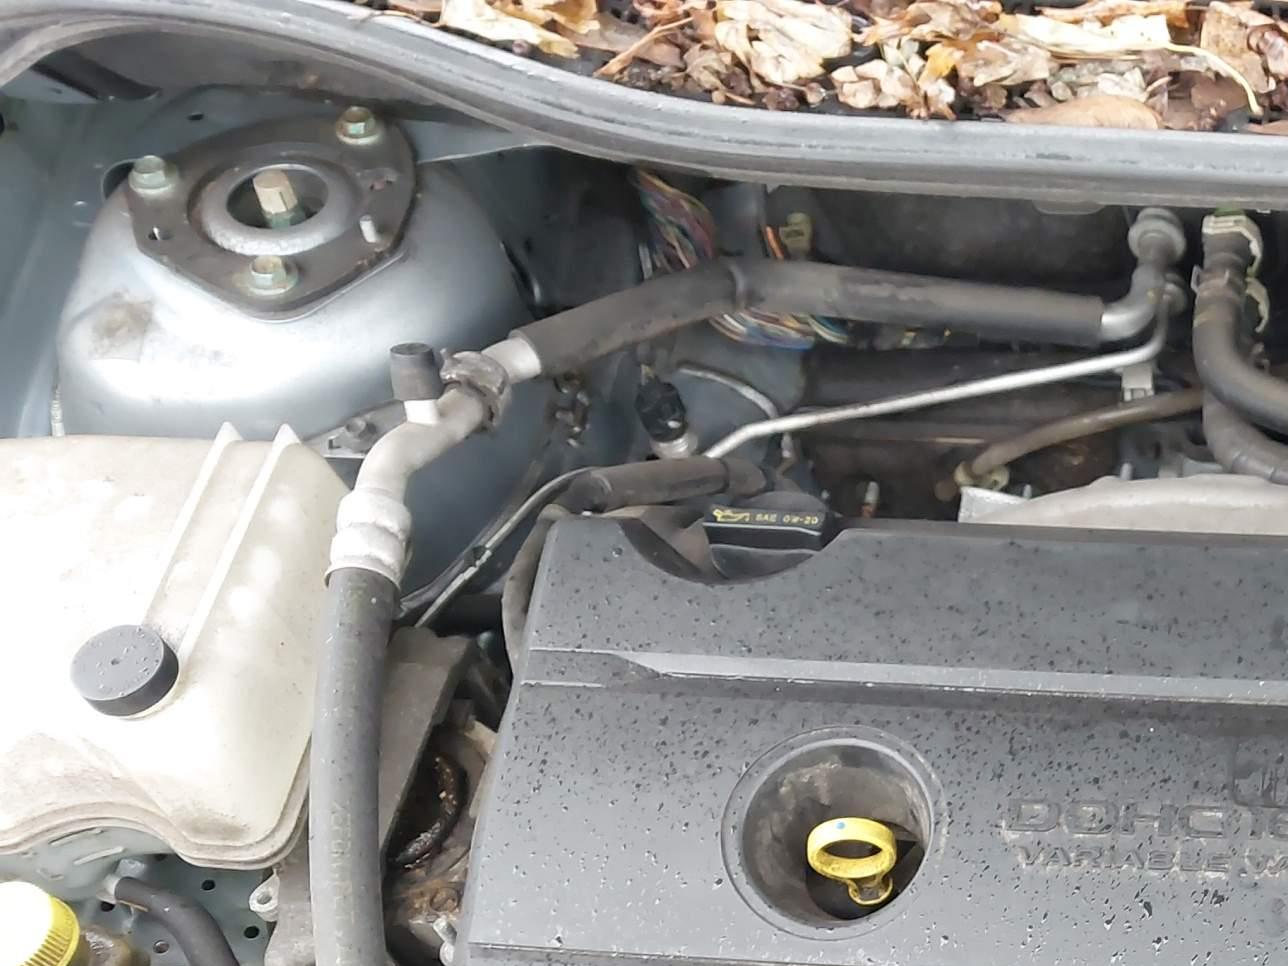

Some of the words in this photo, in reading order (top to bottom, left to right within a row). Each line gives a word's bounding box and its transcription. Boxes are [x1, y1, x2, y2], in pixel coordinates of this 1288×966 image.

[755, 513, 777, 523] SAE
[783, 514, 819, 525] 0W-20
[1006, 799, 1229, 839] DOHC
[1018, 847, 1231, 873] VARIABLE
